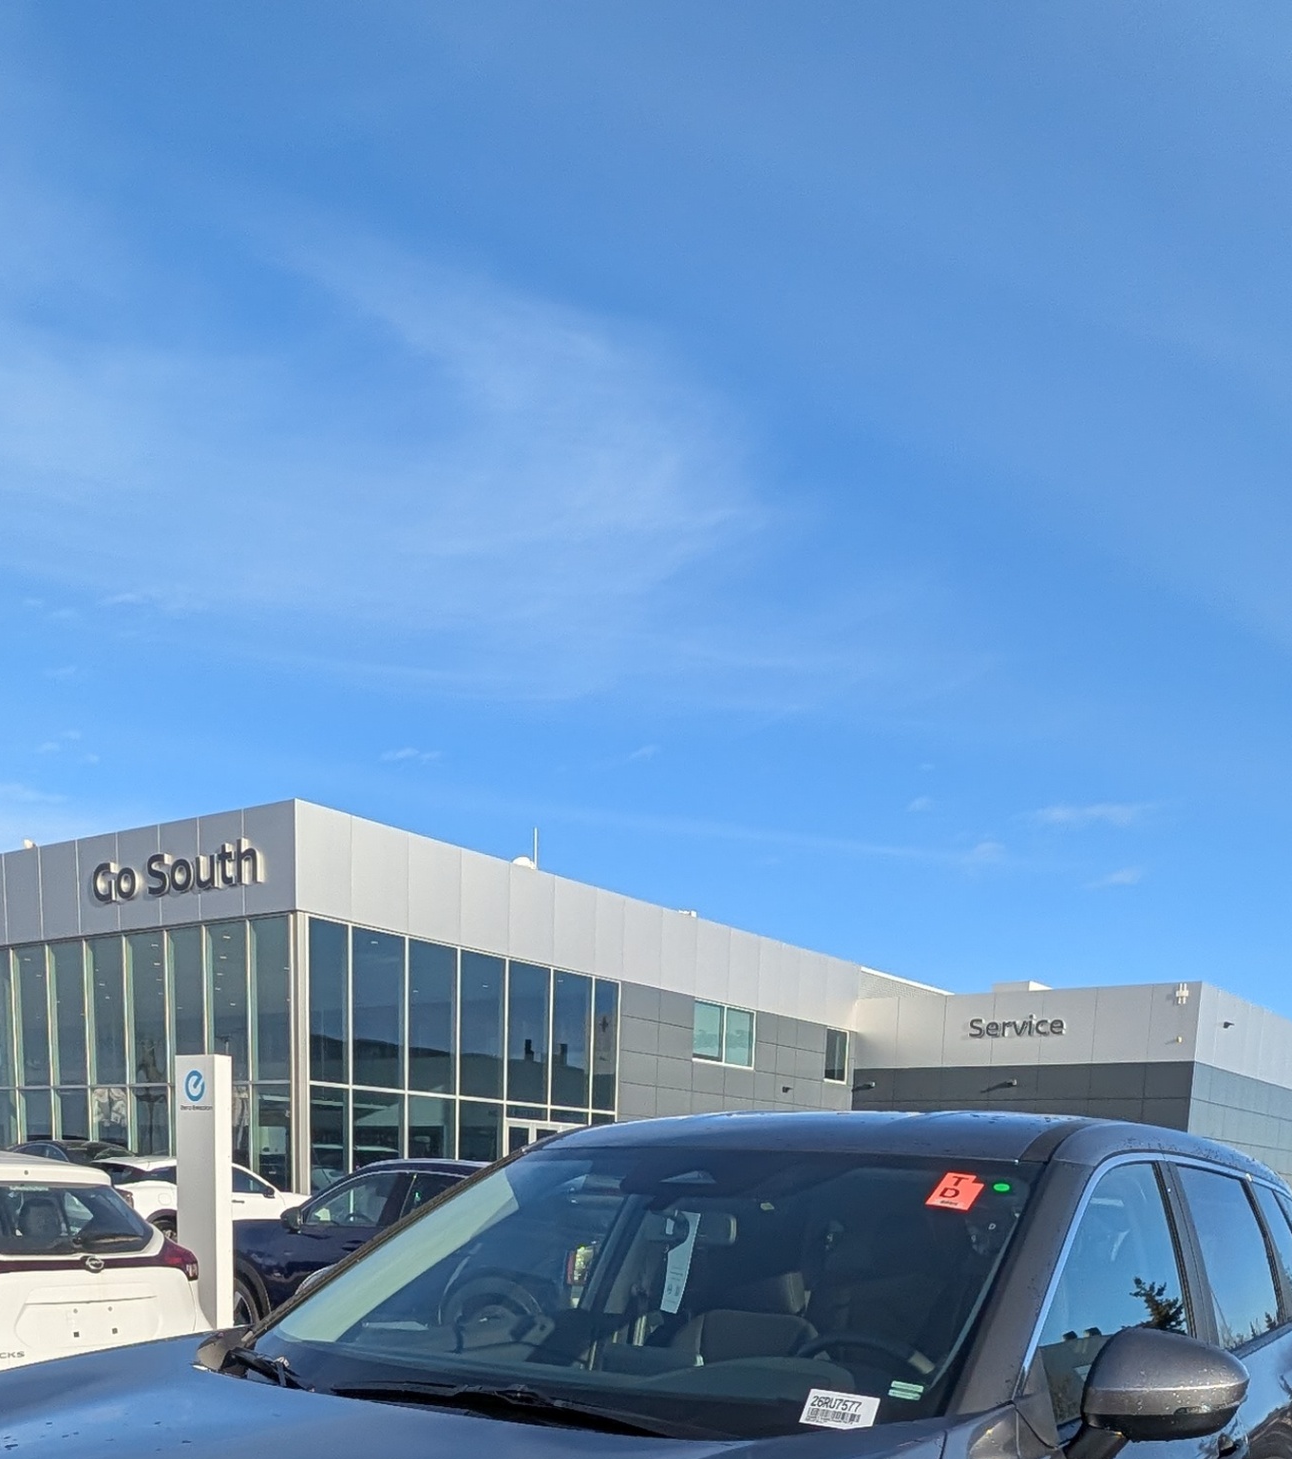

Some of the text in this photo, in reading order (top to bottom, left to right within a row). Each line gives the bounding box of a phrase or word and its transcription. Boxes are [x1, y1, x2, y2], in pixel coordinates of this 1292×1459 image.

[92, 837, 265, 902] Go South
[968, 1014, 1066, 1038] Service
[952, 1175, 969, 1186] T
[939, 1187, 960, 1198] D
[810, 1395, 862, 1413] 26RU7577
